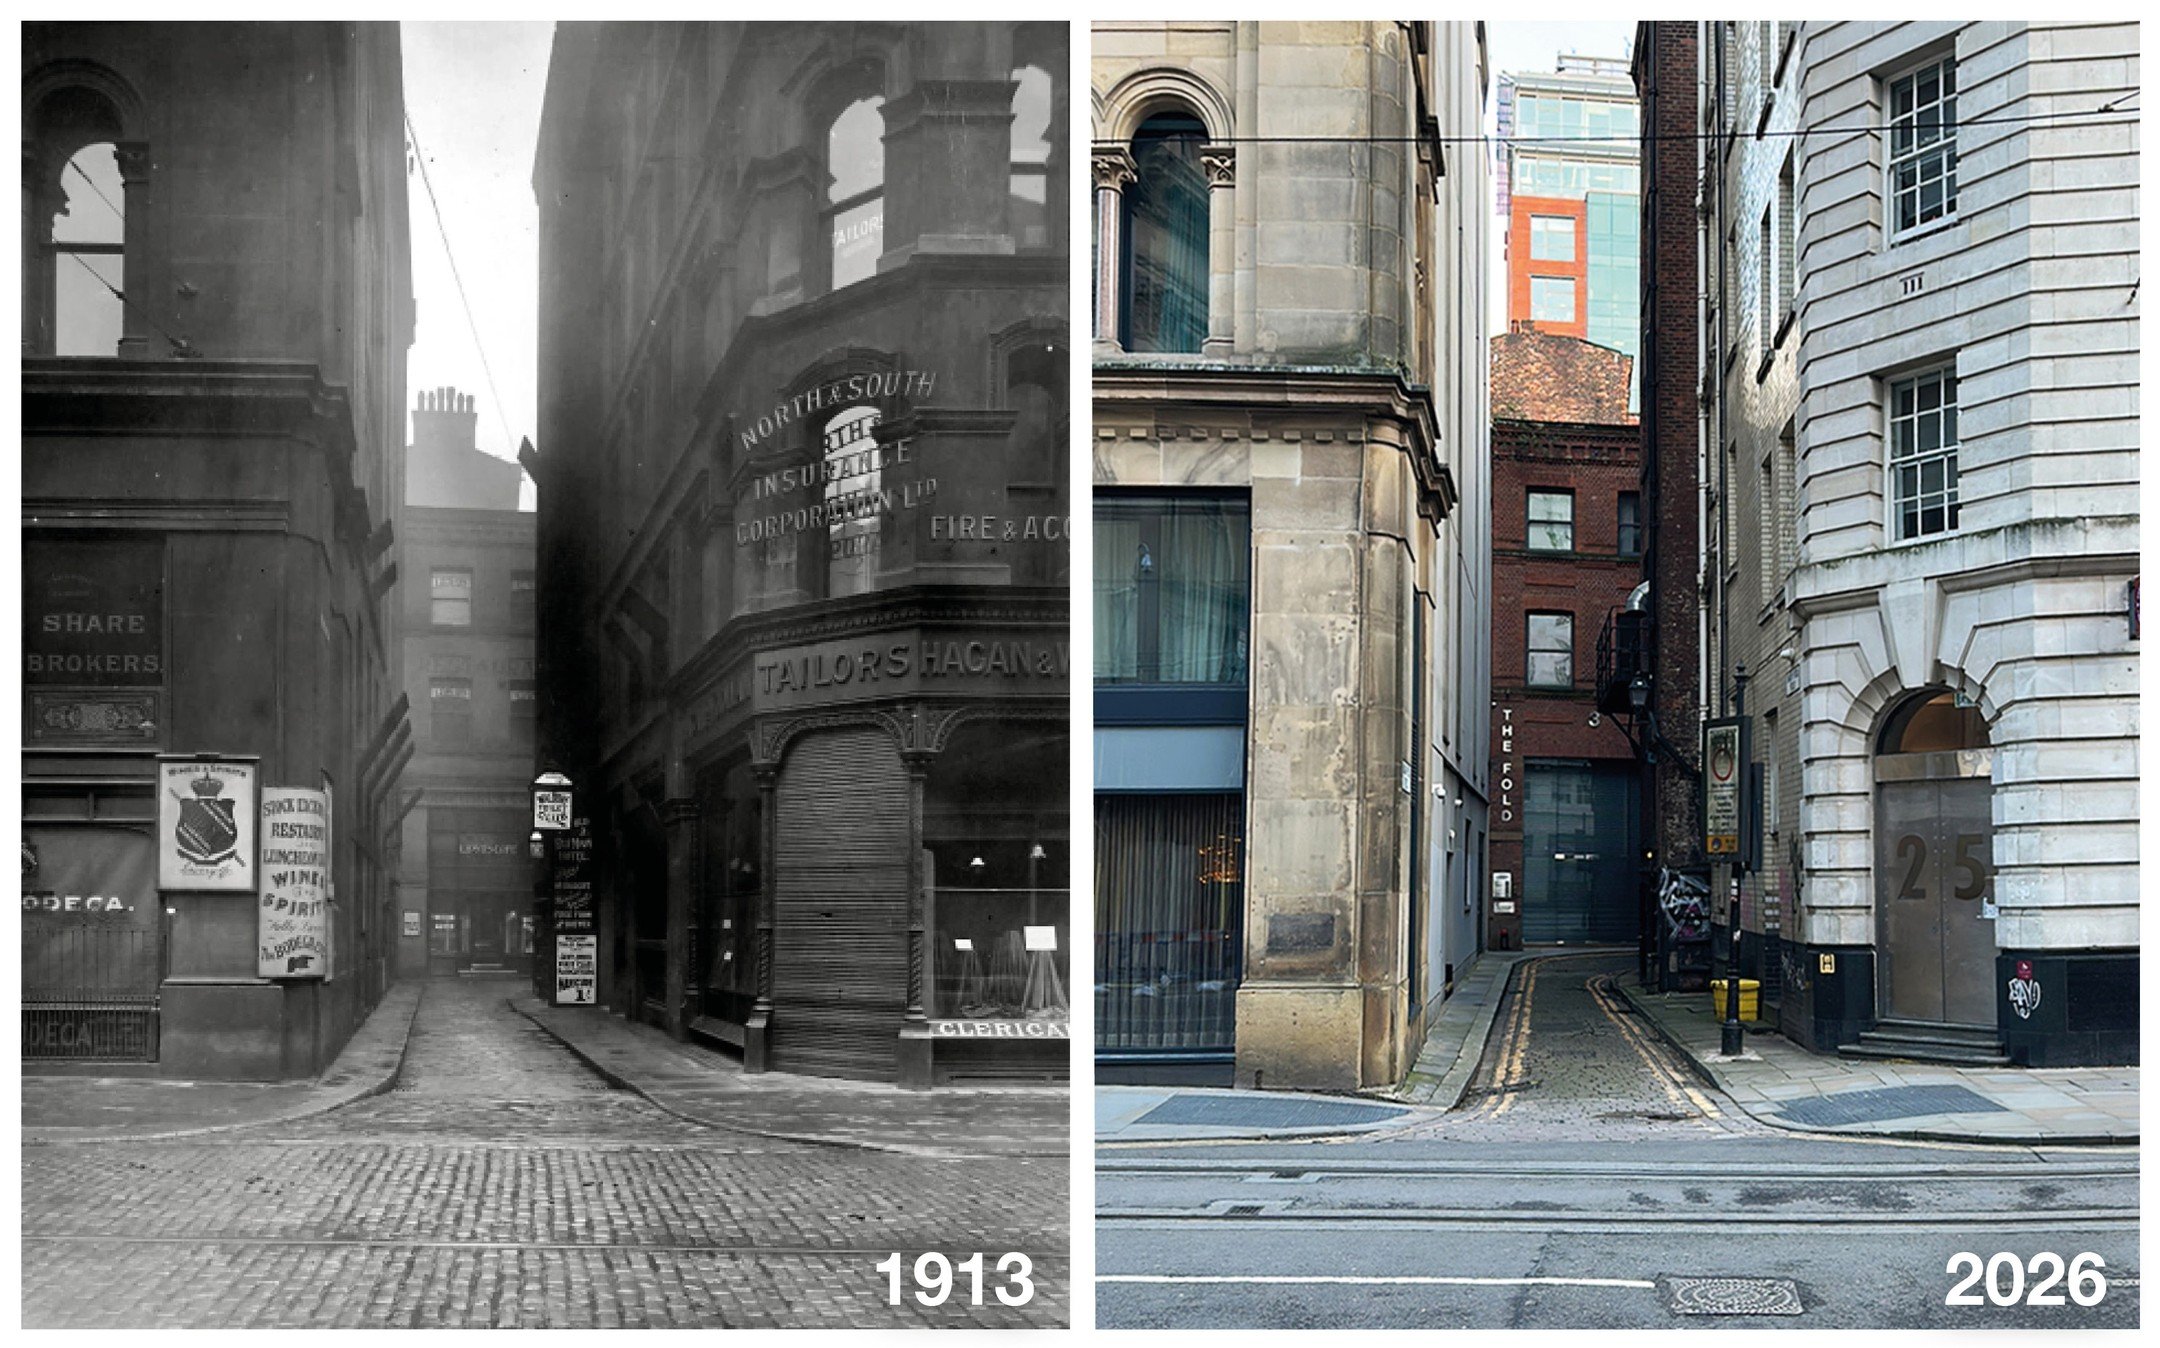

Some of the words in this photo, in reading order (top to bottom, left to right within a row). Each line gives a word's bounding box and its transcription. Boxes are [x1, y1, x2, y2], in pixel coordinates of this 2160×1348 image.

[741, 387, 823, 451] NORTH
[828, 385, 842, 404] &
[847, 370, 937, 401] SOUTH
[930, 515, 997, 541] FIRE
[1003, 520, 1018, 541] &
[42, 613, 146, 634] SHARE
[756, 645, 910, 695] TAILORS
[919, 641, 1032, 678] HAGAN
[1037, 650, 1054, 677] &
[1502, 709, 1512, 752] THE
[1588, 711, 1600, 727] 3
[1501, 763, 1513, 822] FOLD
[1896, 834, 1986, 900] 25
